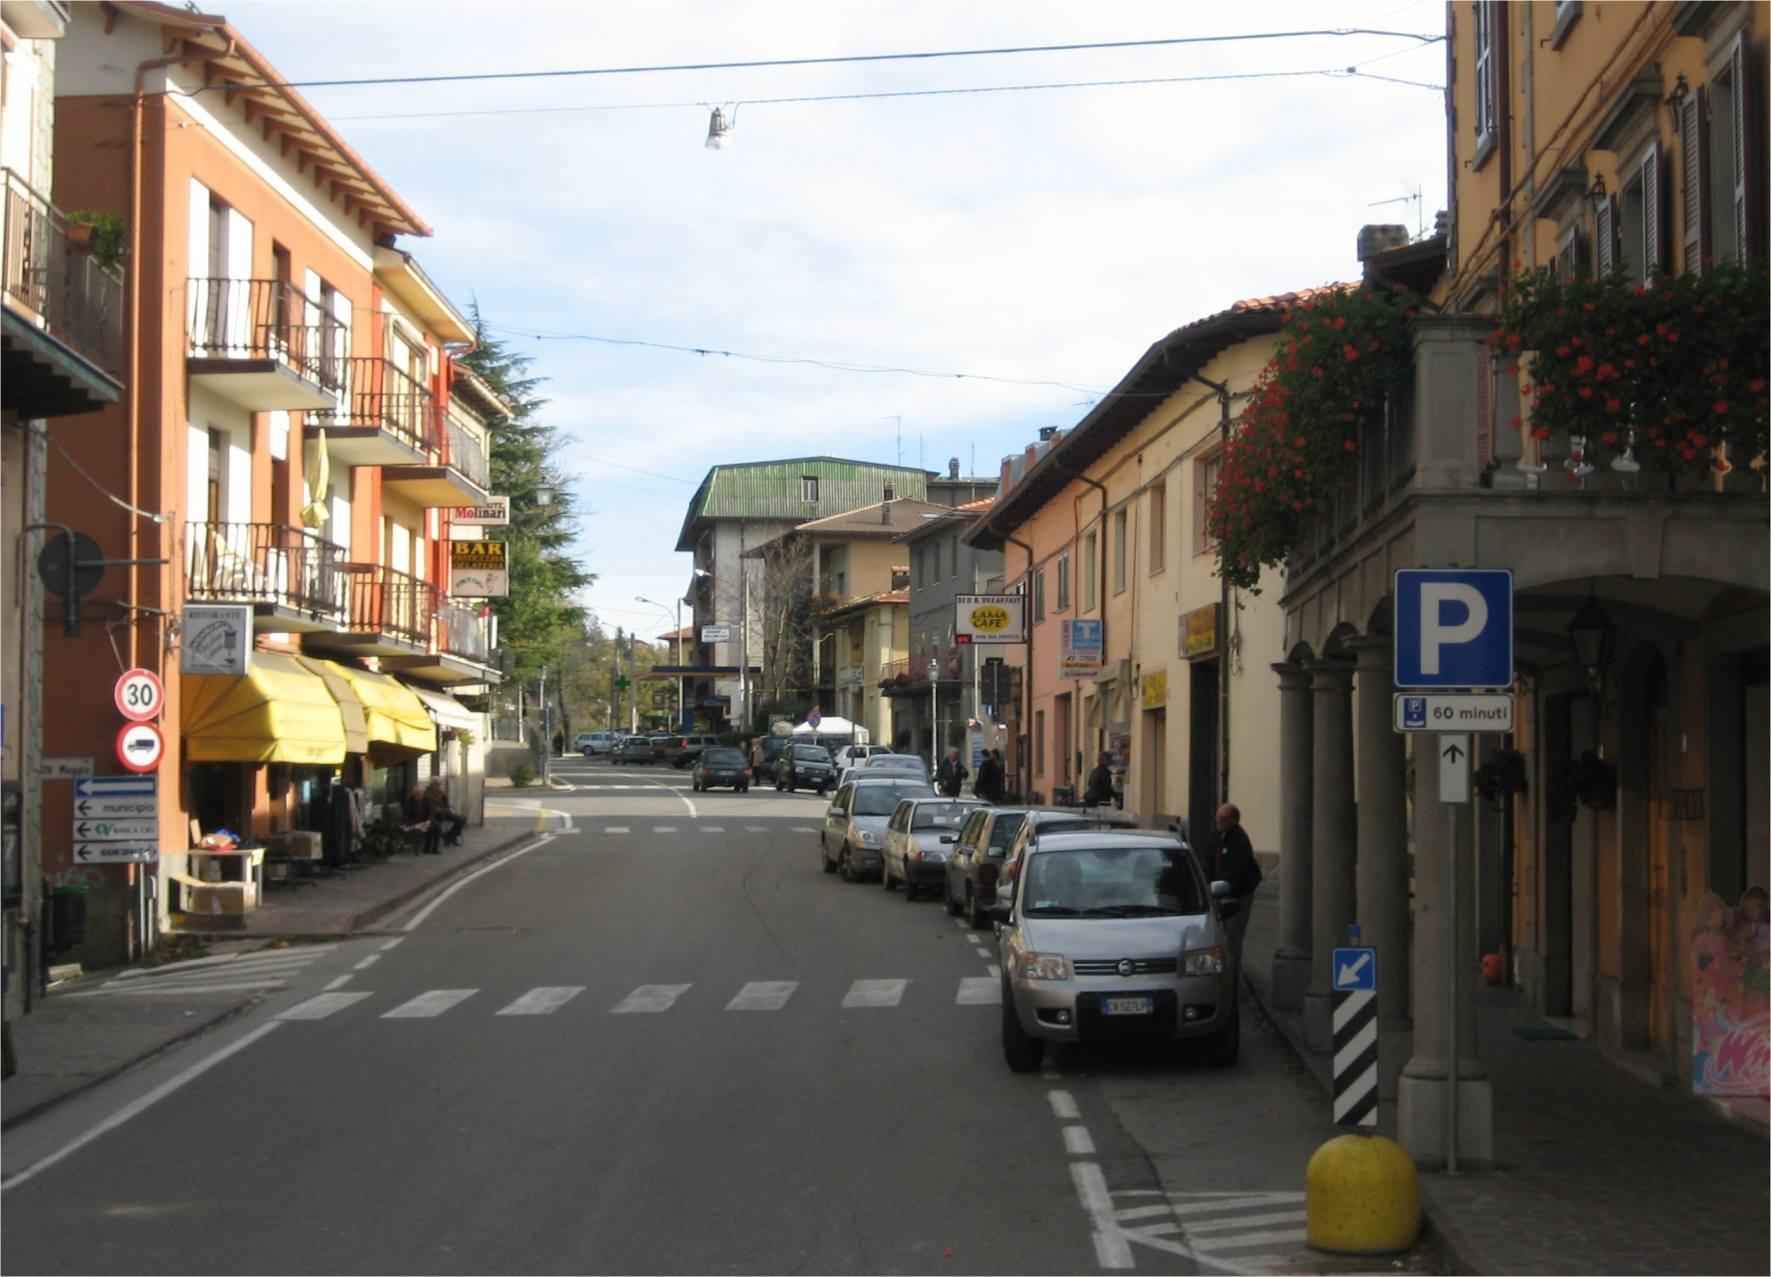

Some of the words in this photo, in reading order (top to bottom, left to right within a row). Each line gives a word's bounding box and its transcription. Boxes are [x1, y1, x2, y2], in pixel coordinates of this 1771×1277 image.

[456, 508, 506, 519] Molinari
[456, 543, 502, 554] BAR
[188, 611, 241, 620] RISTORANTE
[1420, 582, 1488, 675] P
[127, 683, 153, 706] 30
[1433, 707, 1453, 720] 60
[1460, 707, 1508, 720] minuti
[103, 803, 154, 815] municipio
